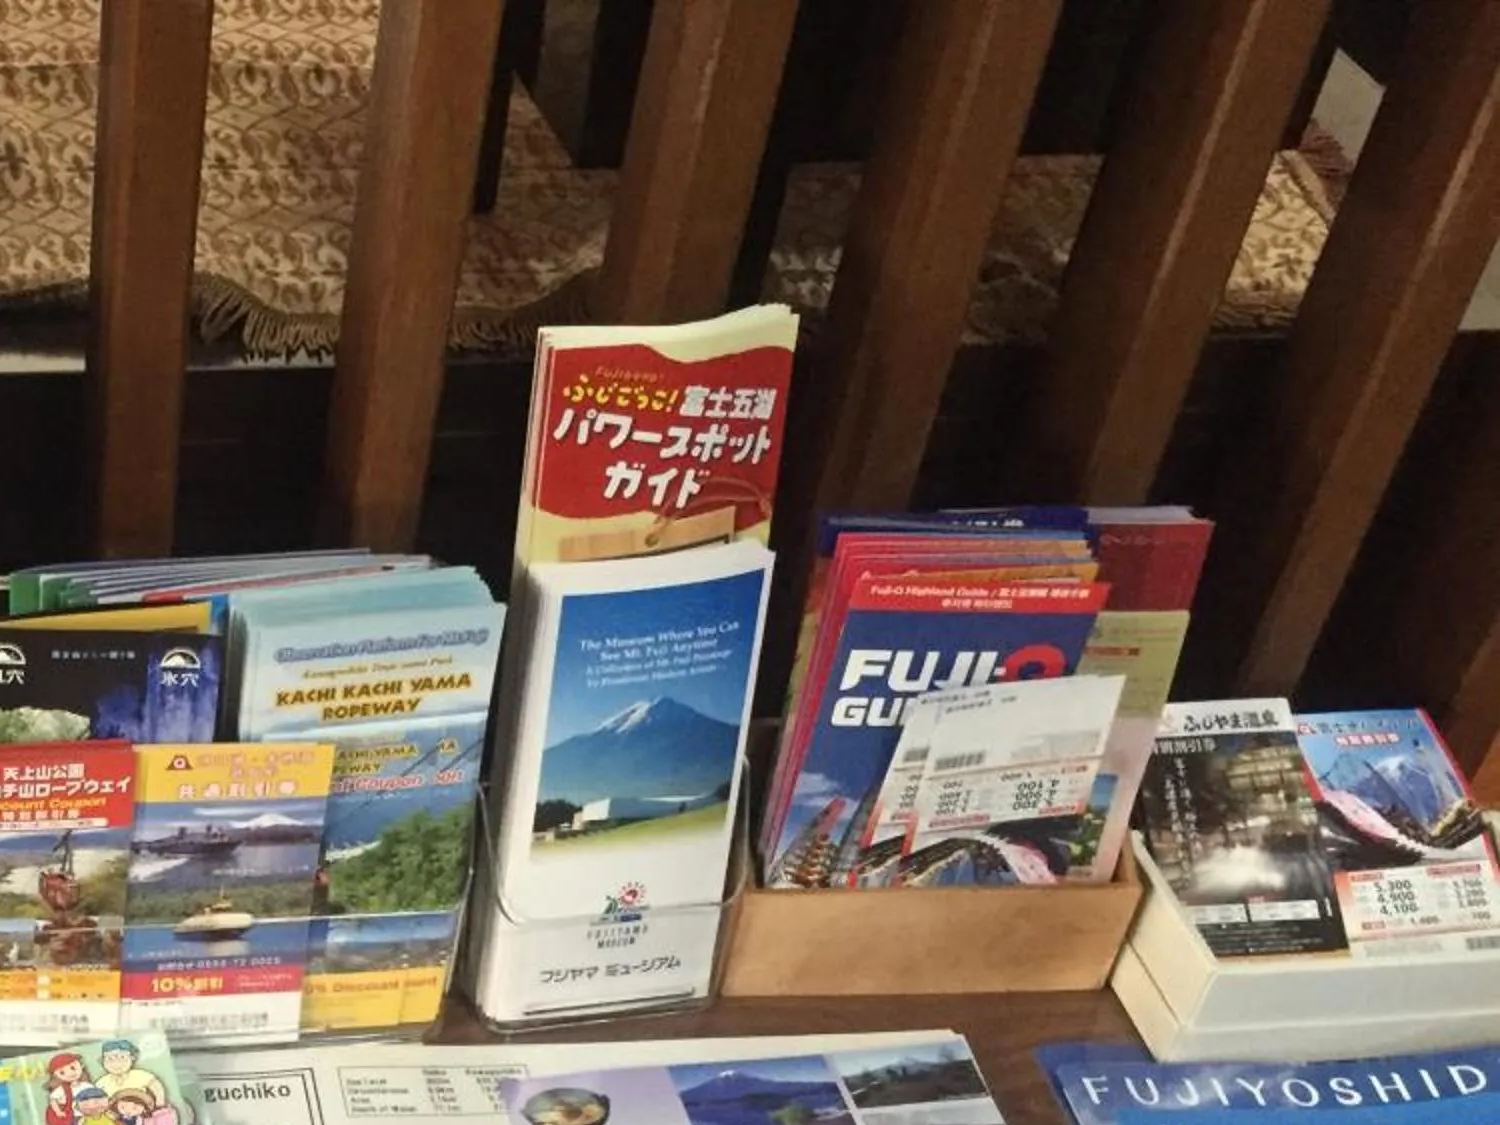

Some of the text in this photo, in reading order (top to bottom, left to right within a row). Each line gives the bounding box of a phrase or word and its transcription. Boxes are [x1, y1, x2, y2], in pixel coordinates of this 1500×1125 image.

[679, 385, 778, 421] 富士五湖
[553, 407, 772, 464] パワースポット
[603, 460, 710, 509] ガイド
[658, 630, 693, 644] Where
[276, 673, 473, 707] KACHI KACHI YAMA
[322, 699, 422, 721] ROPEWAY
[540, 955, 682, 984] フジヤマ ミュージアム
